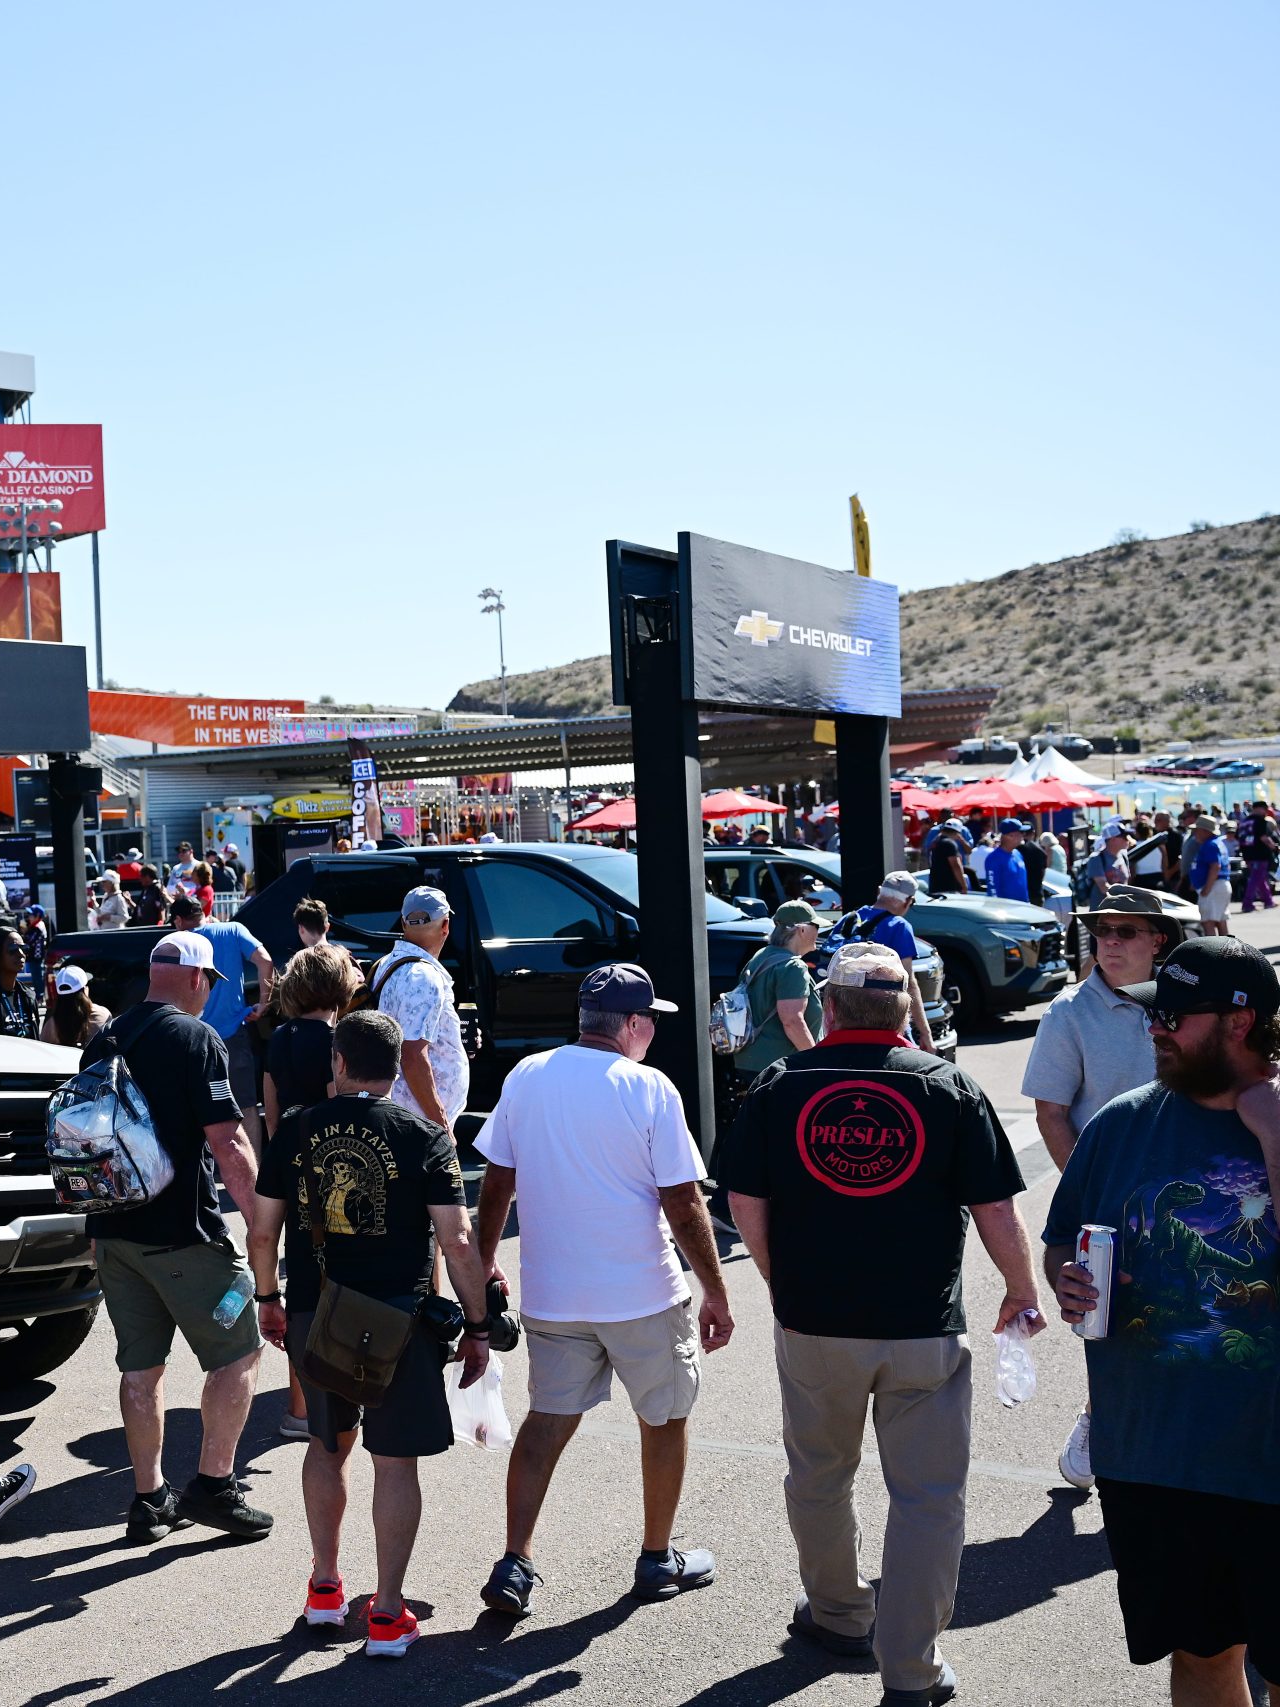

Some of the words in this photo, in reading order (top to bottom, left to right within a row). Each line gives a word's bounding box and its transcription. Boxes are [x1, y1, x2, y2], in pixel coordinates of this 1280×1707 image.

[8, 470, 93, 483] DIAMOND
[33, 486, 74, 495] CASINO
[789, 625, 873, 657] CHEVROLET
[188, 705, 216, 721] THE
[221, 705, 250, 721] FUN
[195, 728, 210, 743] IN
[213, 728, 242, 743] THE
[809, 1126, 913, 1147] PRESLEY
[324, 1124, 340, 1138] IN
[345, 1123, 355, 1135] A
[361, 1127, 399, 1180] TAVERN
[824, 1151, 894, 1177] MOTORS
